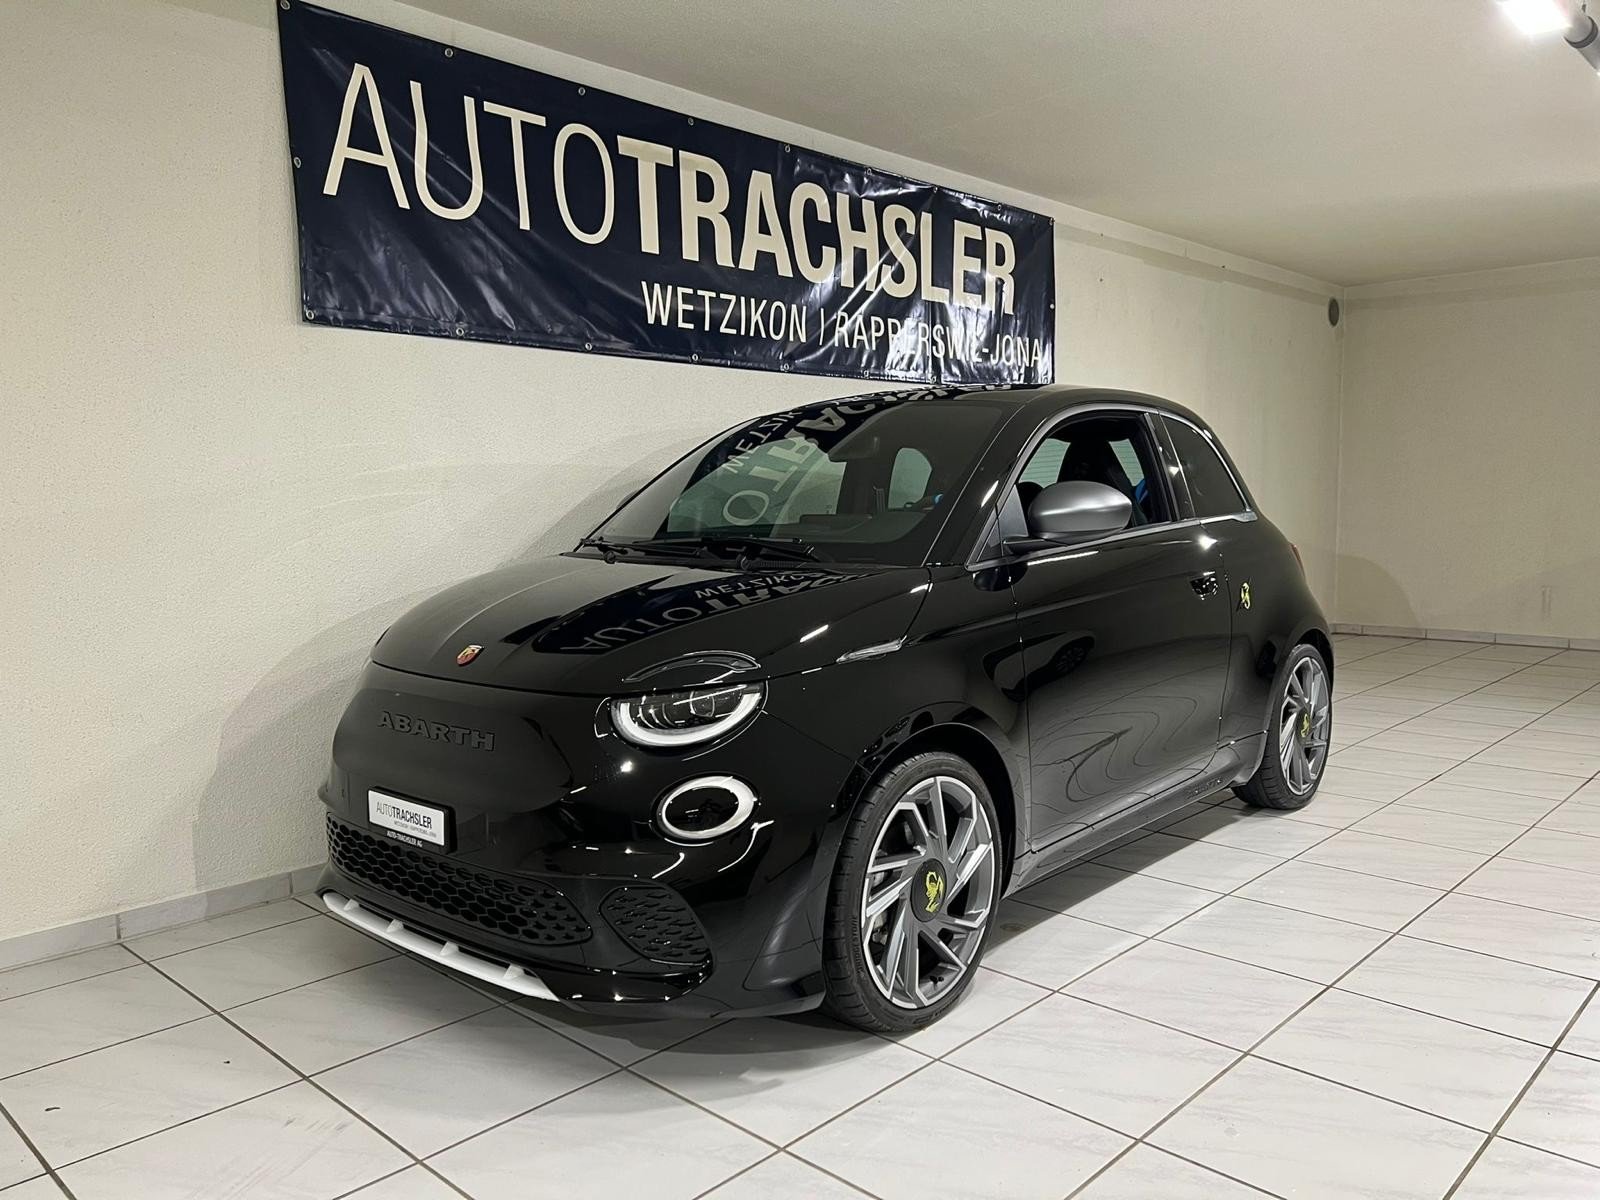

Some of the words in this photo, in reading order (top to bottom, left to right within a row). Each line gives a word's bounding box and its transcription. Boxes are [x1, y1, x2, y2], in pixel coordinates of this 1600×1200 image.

[323, 62, 1016, 316] AUTOTRACHSLER
[641, 280, 807, 343] WETZIKON
[378, 710, 495, 752] ABARTH
[376, 801, 433, 829] AUTOTRACHSLER
